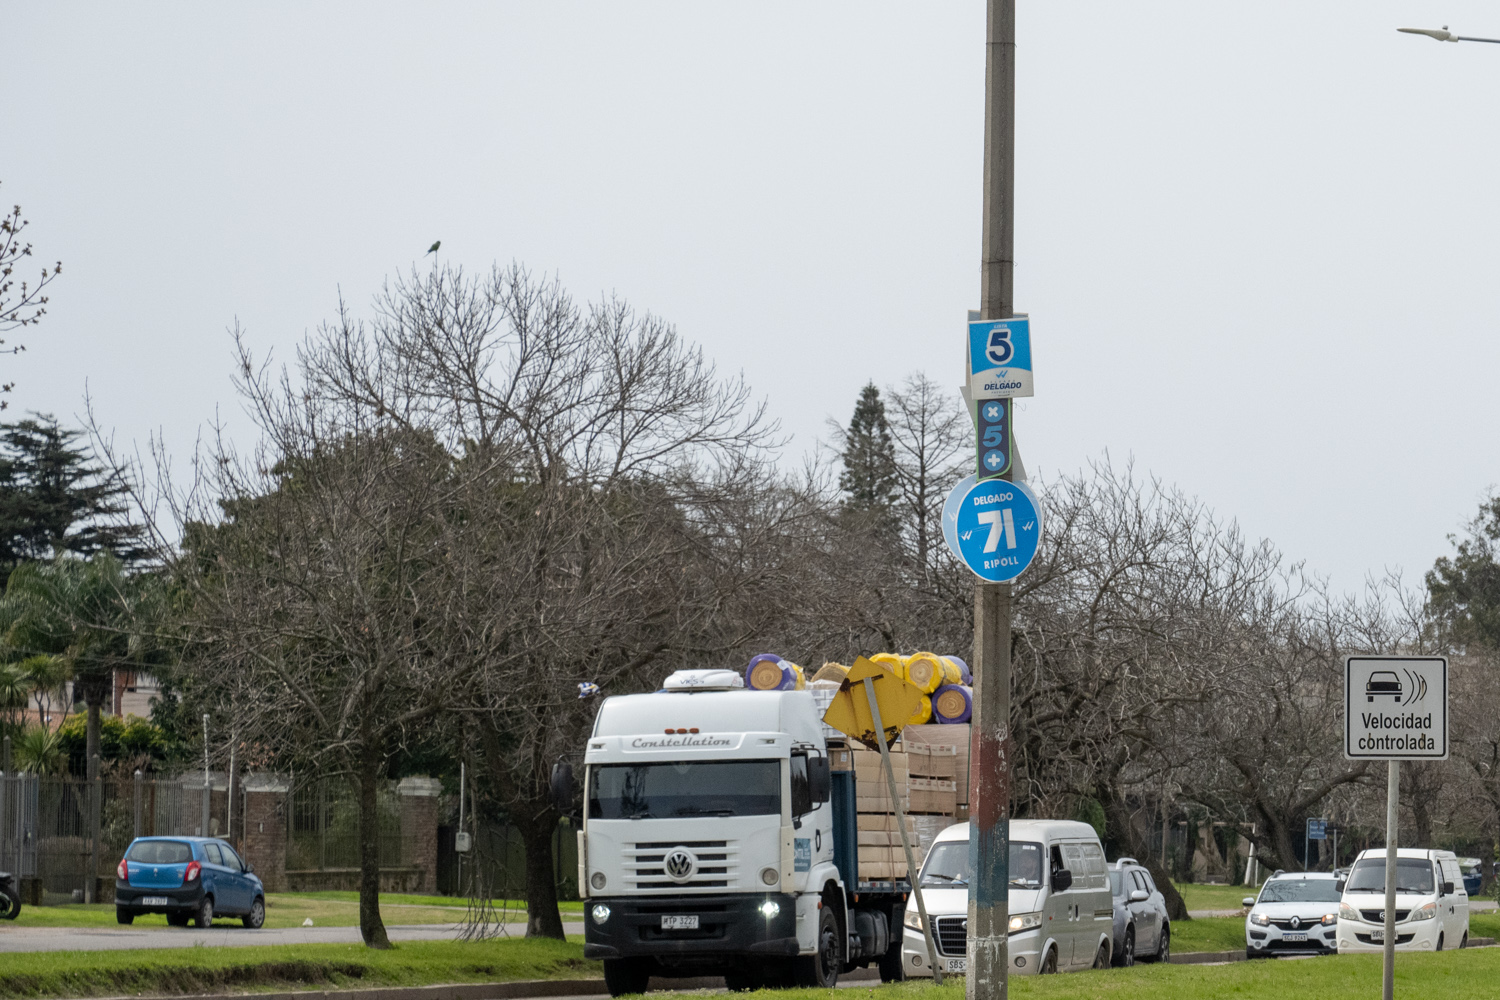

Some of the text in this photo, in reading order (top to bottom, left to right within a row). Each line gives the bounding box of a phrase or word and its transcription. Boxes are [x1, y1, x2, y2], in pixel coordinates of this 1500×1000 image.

[987, 330, 1013, 364] 5
[983, 382, 1022, 390] DELGADO
[982, 425, 1002, 448] 5
[974, 492, 1014, 506] DELGADO
[977, 508, 1017, 554] 71
[984, 555, 1019, 570] RIPOLL
[1362, 712, 1432, 728] Velocidad
[632, 736, 731, 748] Constellation
[1358, 733, 1434, 750] controlada
